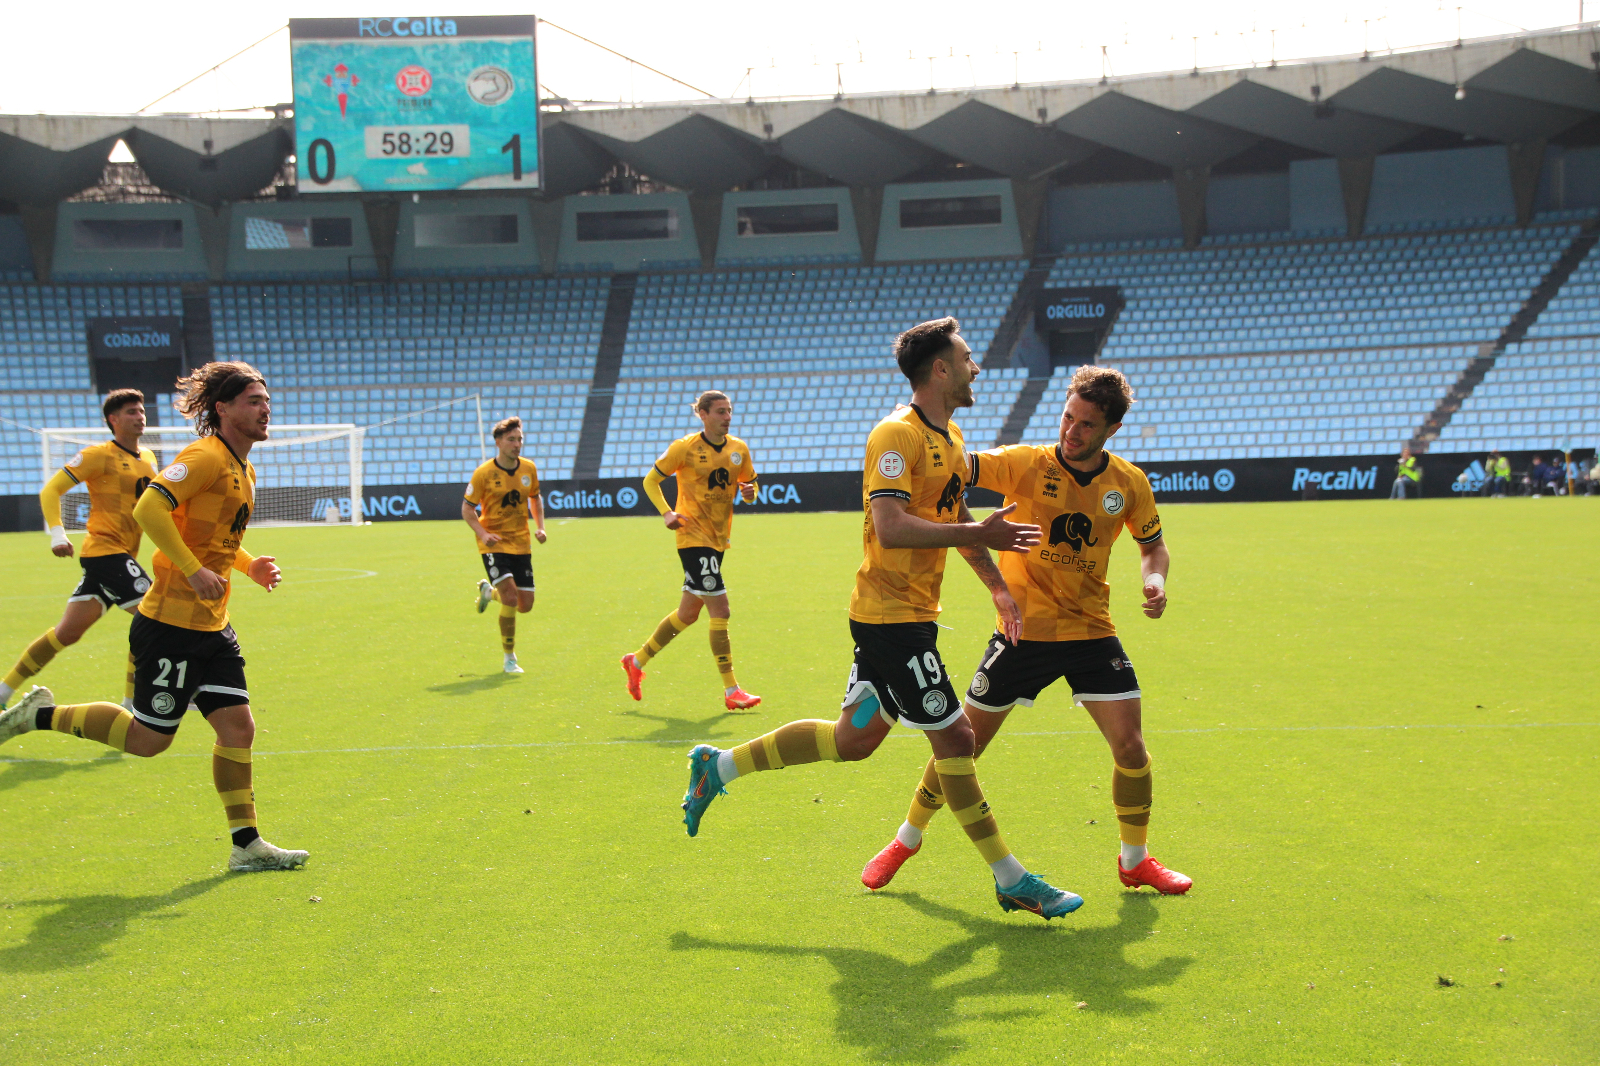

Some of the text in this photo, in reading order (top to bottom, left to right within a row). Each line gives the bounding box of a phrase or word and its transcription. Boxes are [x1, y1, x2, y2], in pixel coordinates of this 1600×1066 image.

[382, 132, 454, 156] 58:29
[307, 137, 336, 185] 0
[501, 134, 522, 181] 1
[1046, 303, 1105, 319] ORGULLO
[1147, 471, 1210, 493] Galicia
[1291, 465, 1378, 491] Recalvi
[548, 490, 612, 510] Galicia
[125, 559, 141, 578] 6
[699, 556, 720, 576] 20
[983, 640, 1006, 670] 7
[152, 657, 188, 689] 21
[906, 651, 942, 690] 19
